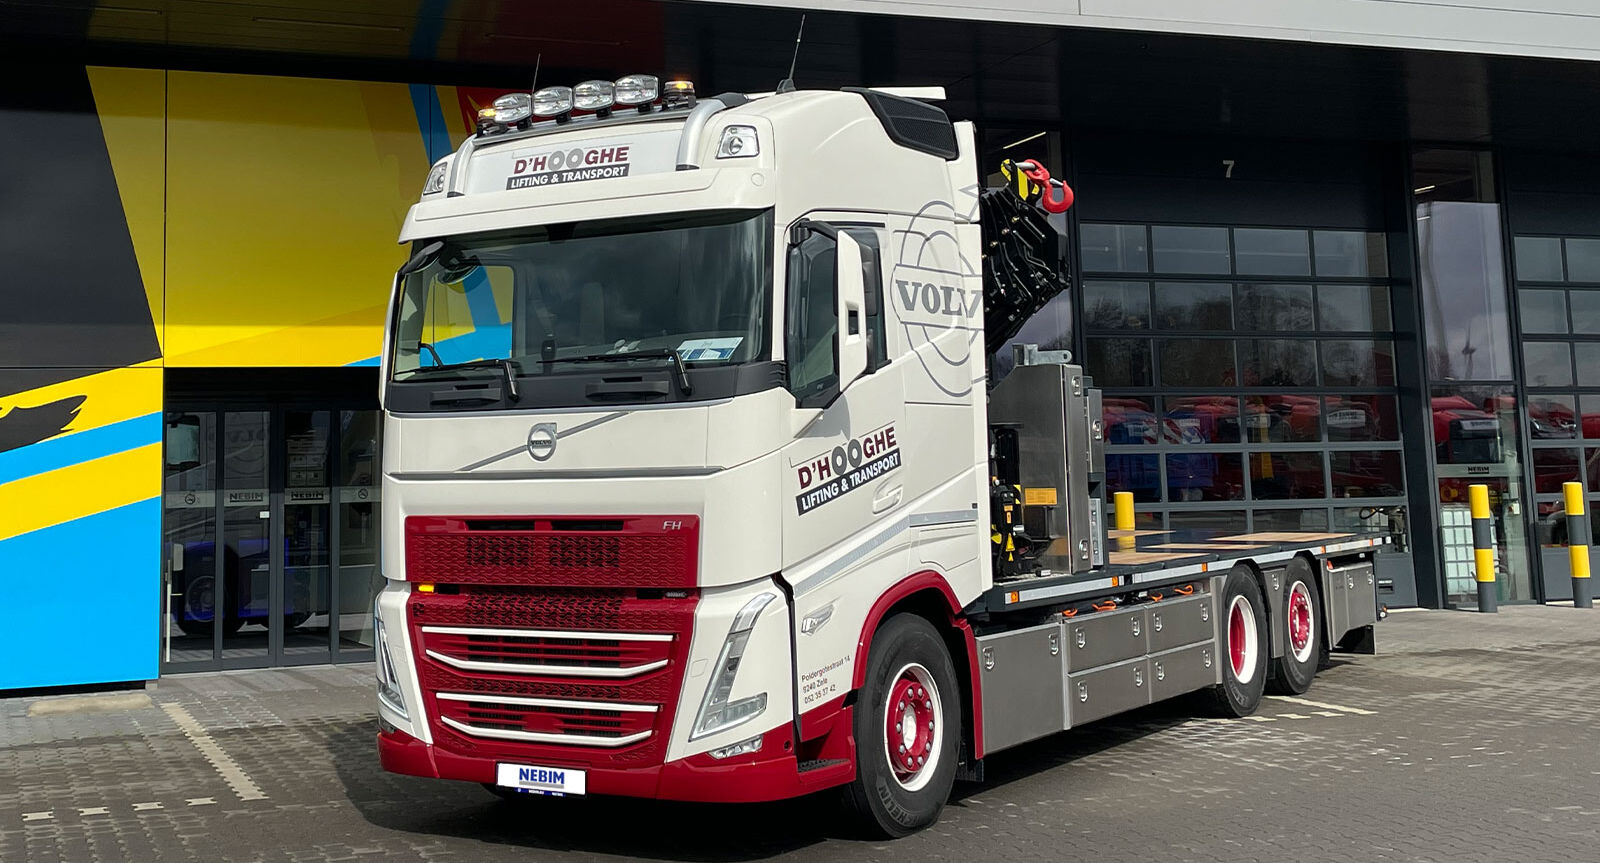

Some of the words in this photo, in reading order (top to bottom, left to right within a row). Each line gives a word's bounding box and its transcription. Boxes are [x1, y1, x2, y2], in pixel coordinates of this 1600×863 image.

[513, 147, 630, 175] D'HOOGHE
[1222, 159, 1235, 178] 7
[510, 174, 549, 189] LIFTING
[550, 173, 560, 184] &
[561, 166, 626, 182] TRANSPORT
[797, 426, 897, 490] D'HOOGHE
[801, 482, 839, 511] LIFTING
[841, 477, 849, 492] &
[849, 452, 899, 487] TRANSPORT
[229, 492, 264, 501] NEBIM
[290, 490, 324, 499] NEBIM
[663, 520, 682, 530] FH
[519, 767, 565, 785] NEBIM
